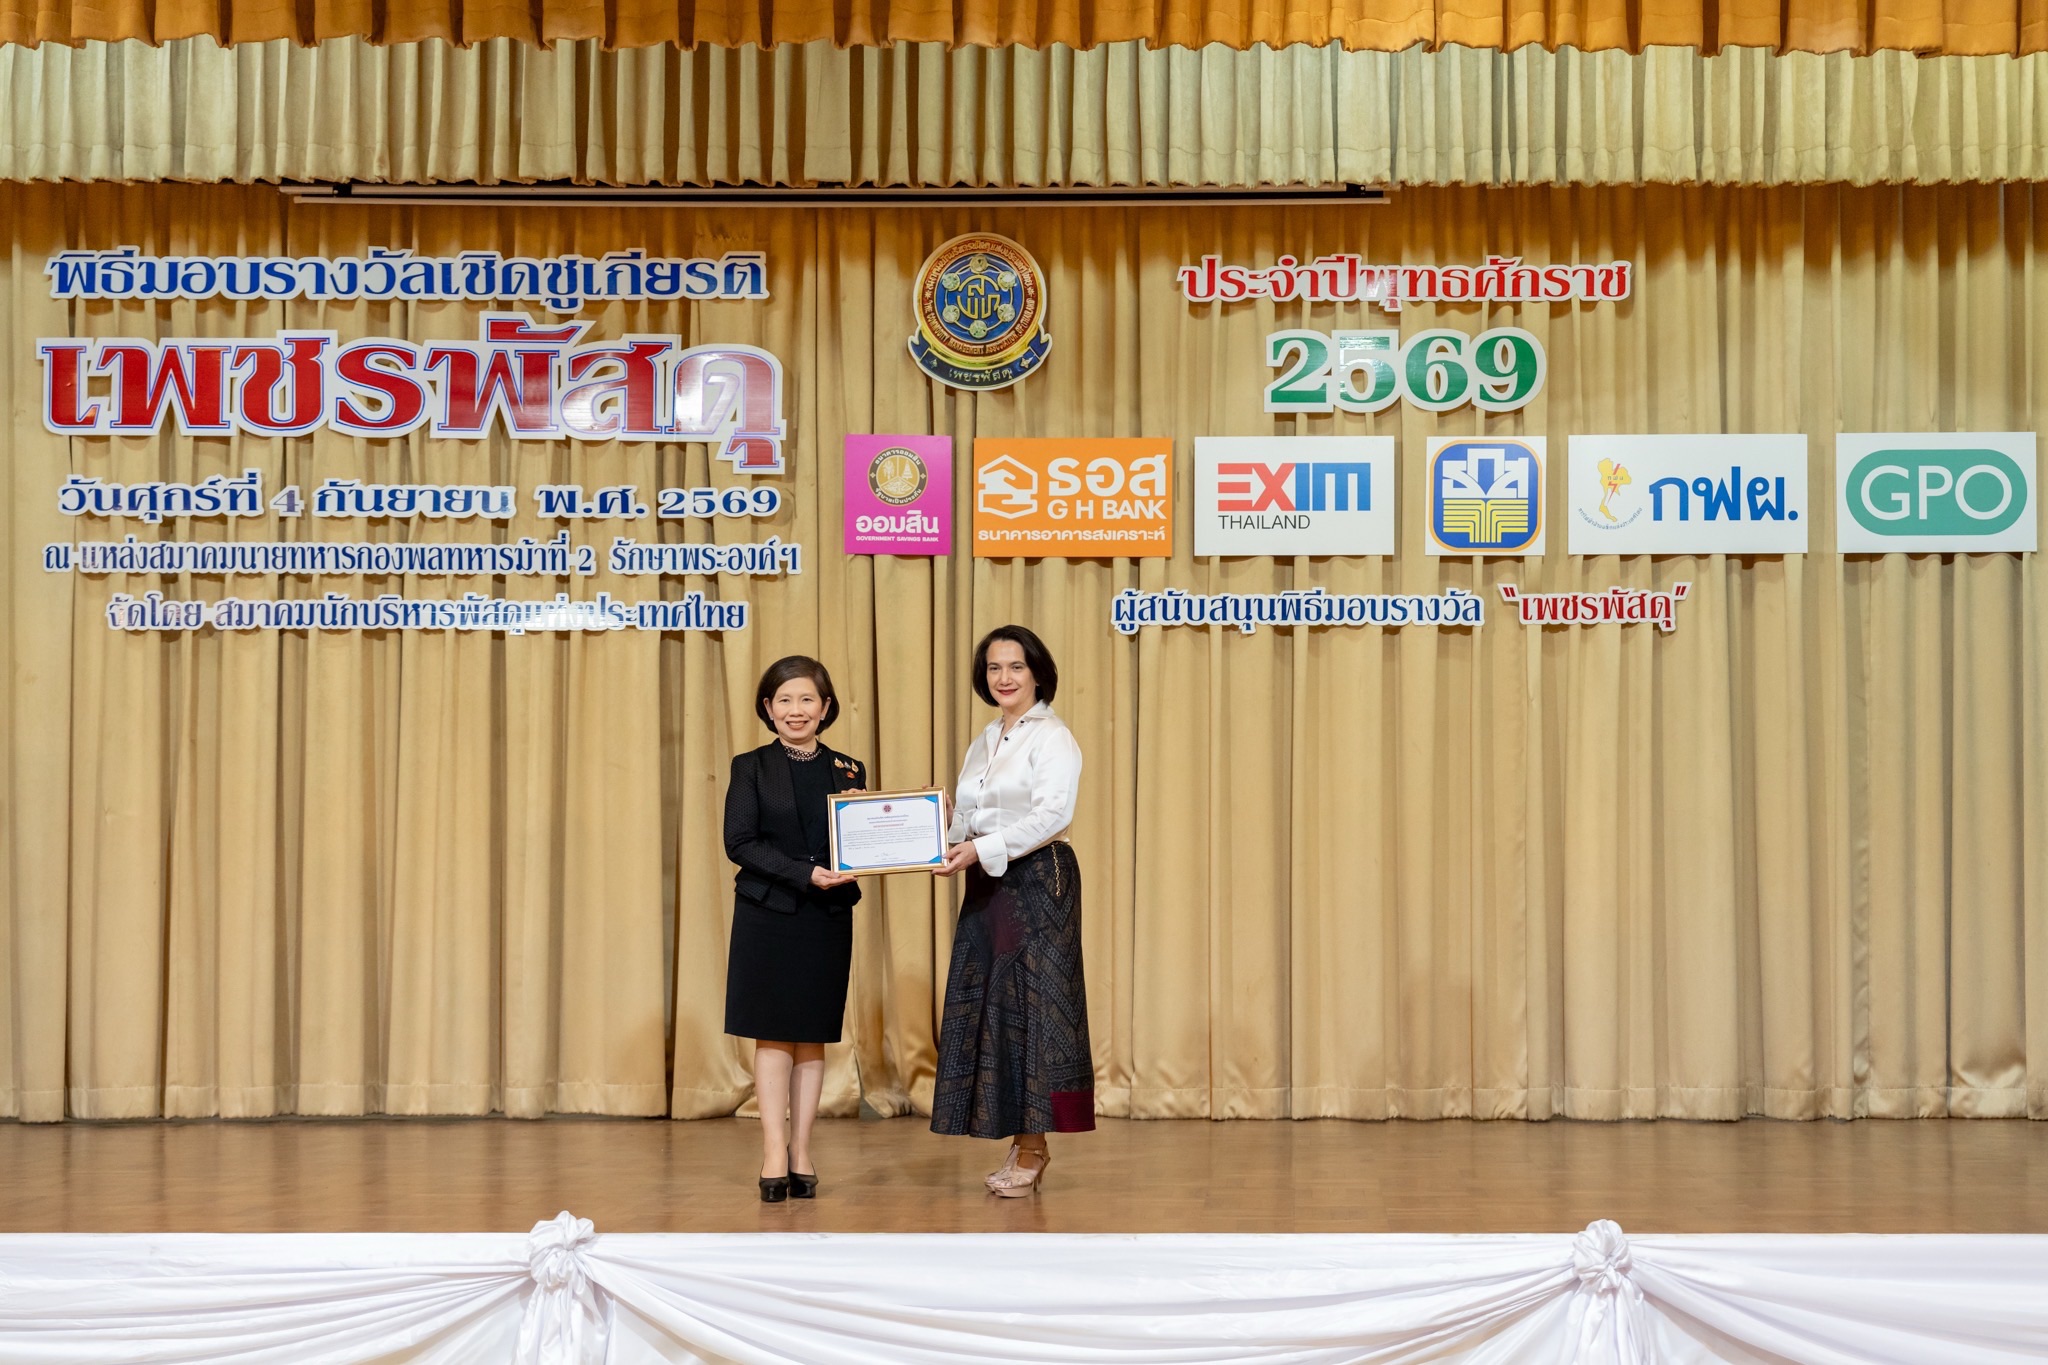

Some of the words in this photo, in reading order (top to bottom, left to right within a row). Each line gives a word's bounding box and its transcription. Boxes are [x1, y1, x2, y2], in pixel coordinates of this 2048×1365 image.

[50, 249, 767, 309] พิธีมอบรางวัลเชิดชูเกียรติ
[1180, 256, 1630, 309] ประจำปีพุทธศักราช
[1269, 334, 1538, 404] 2569
[41, 318, 781, 468] เพชรพัสดุ
[61, 472, 258, 521] วันศุกร์ที่
[273, 489, 301, 513] 4
[316, 480, 512, 514] กันยายน
[538, 486, 646, 515] พ.ศ.
[661, 488, 779, 515] 2569
[1047, 454, 1168, 497] ธอส
[1217, 462, 1371, 512] EXIM
[1648, 465, 1799, 522] กฟผ.
[1860, 464, 2013, 521] GPO
[855, 509, 940, 534] ออมสิน
[1047, 499, 1068, 520] G
[1075, 499, 1094, 519] H
[1102, 499, 1167, 519] BANK
[1217, 515, 1311, 530] THAILAND
[45, 545, 71, 571] ณ
[81, 533, 568, 572] แหล่งสมาคมนายทหารกองพลทหารม้าที่
[576, 547, 592, 572] 2
[611, 538, 799, 572] รักษาพระองค์ฯ
[978, 525, 1166, 541] ธนาคารอาคารสงเคราะห์
[108, 593, 202, 628] จัดโดย
[1114, 589, 1482, 631] ผู้สนับสนุนพิธีมอบรางวัล
